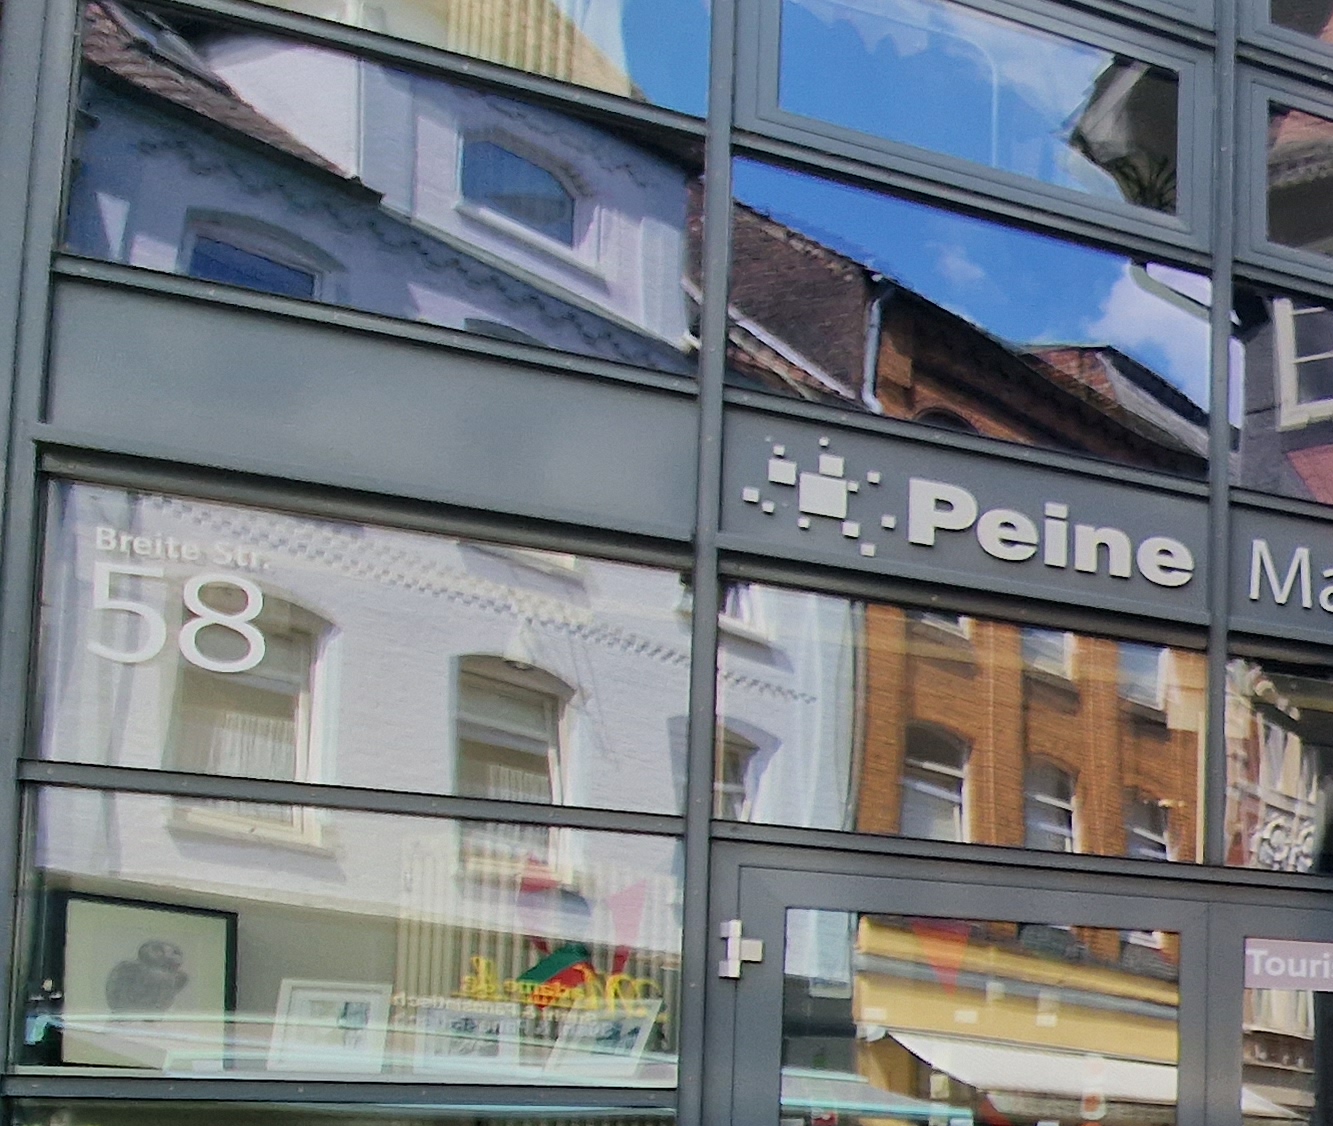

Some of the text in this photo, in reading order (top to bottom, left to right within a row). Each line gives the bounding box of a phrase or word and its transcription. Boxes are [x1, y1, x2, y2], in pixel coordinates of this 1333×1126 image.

[96, 525, 270, 571] Breite Str.
[907, 477, 1196, 588] Peine
[86, 561, 267, 673] 58
